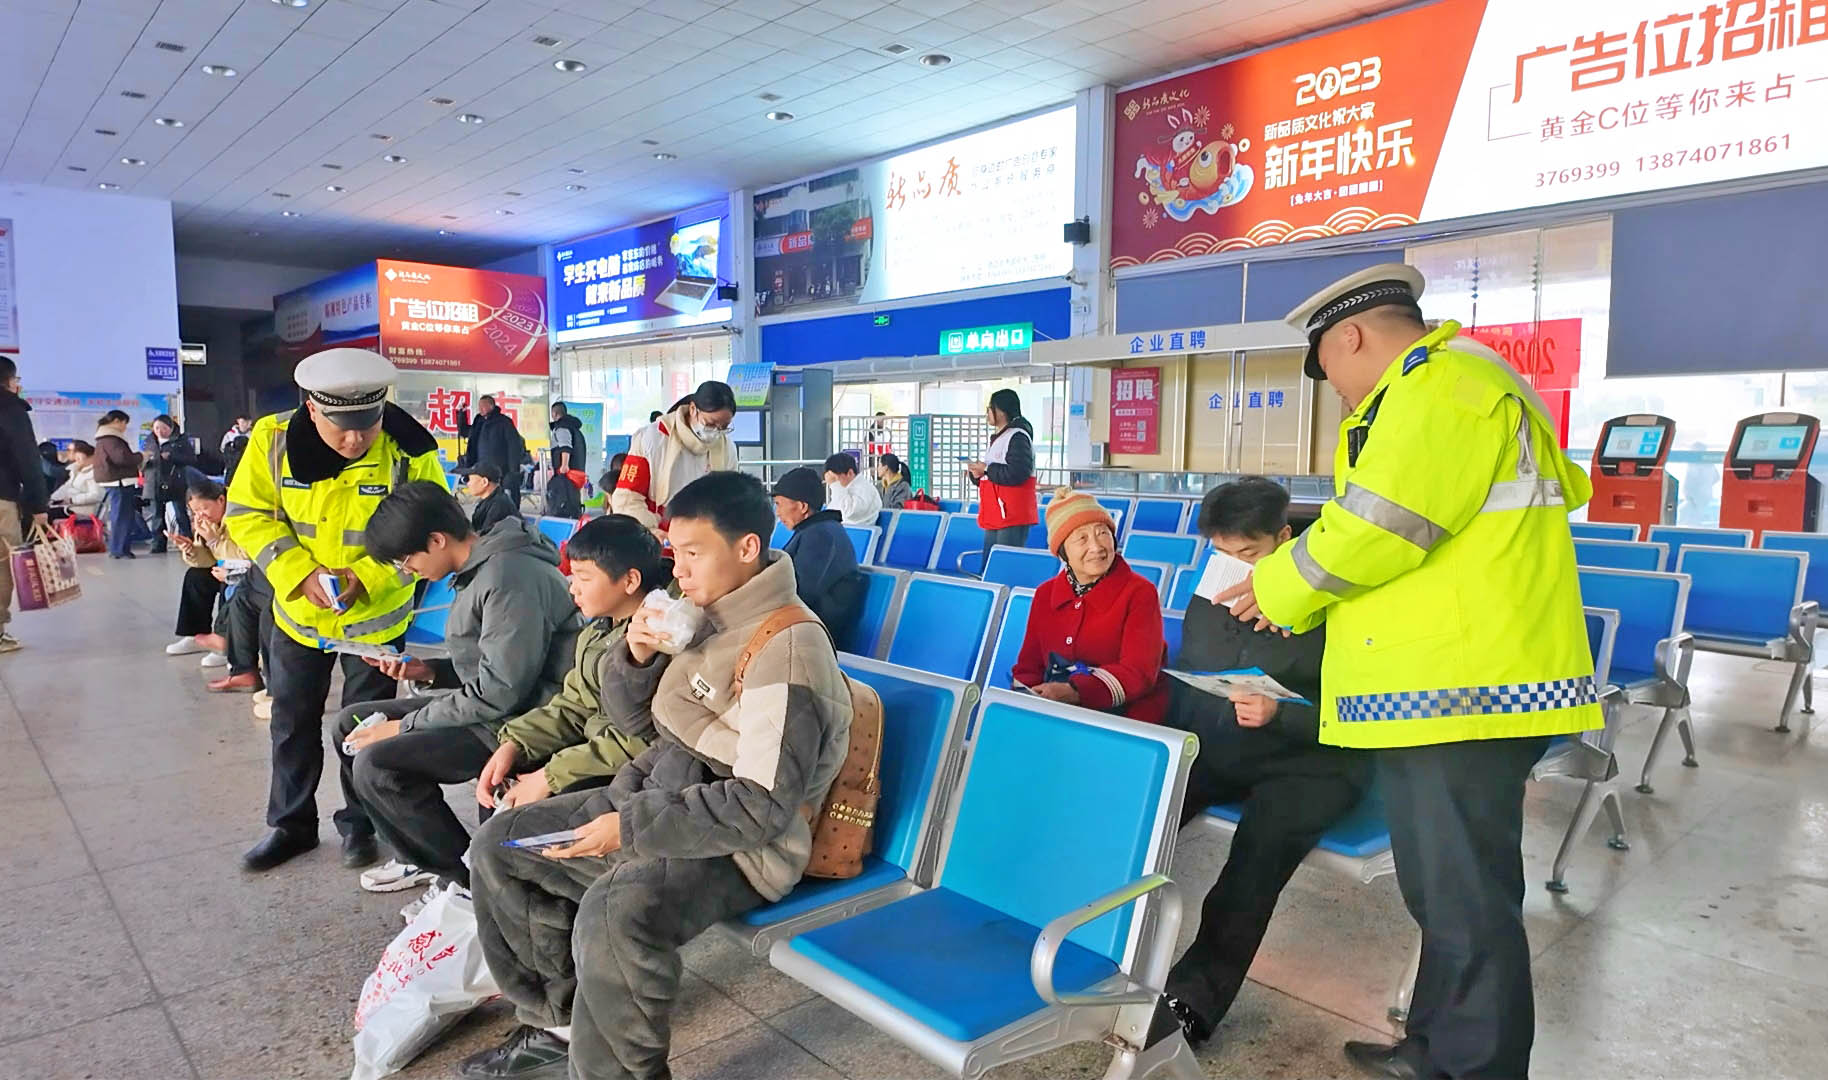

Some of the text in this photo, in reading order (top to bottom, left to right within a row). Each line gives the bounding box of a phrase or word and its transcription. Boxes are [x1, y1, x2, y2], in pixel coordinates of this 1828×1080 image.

[1512, 0, 1828, 104] 广告位招租
[1295, 56, 1382, 106] 2023
[1263, 101, 1376, 142] 新品质文化祝大家
[1539, 73, 1796, 143] 黄金C位等你来占
[1263, 118, 1415, 191] 新年快乐
[1534, 133, 1792, 188] 3769399 13874071861
[563, 254, 621, 287] 学生买电脑
[389, 297, 479, 323] 广告位招租
[501, 311, 534, 331] 2023
[483, 324, 518, 356] 2024
[1130, 330, 1207, 354] 企业直聘
[1117, 379, 1155, 401] 招聘
